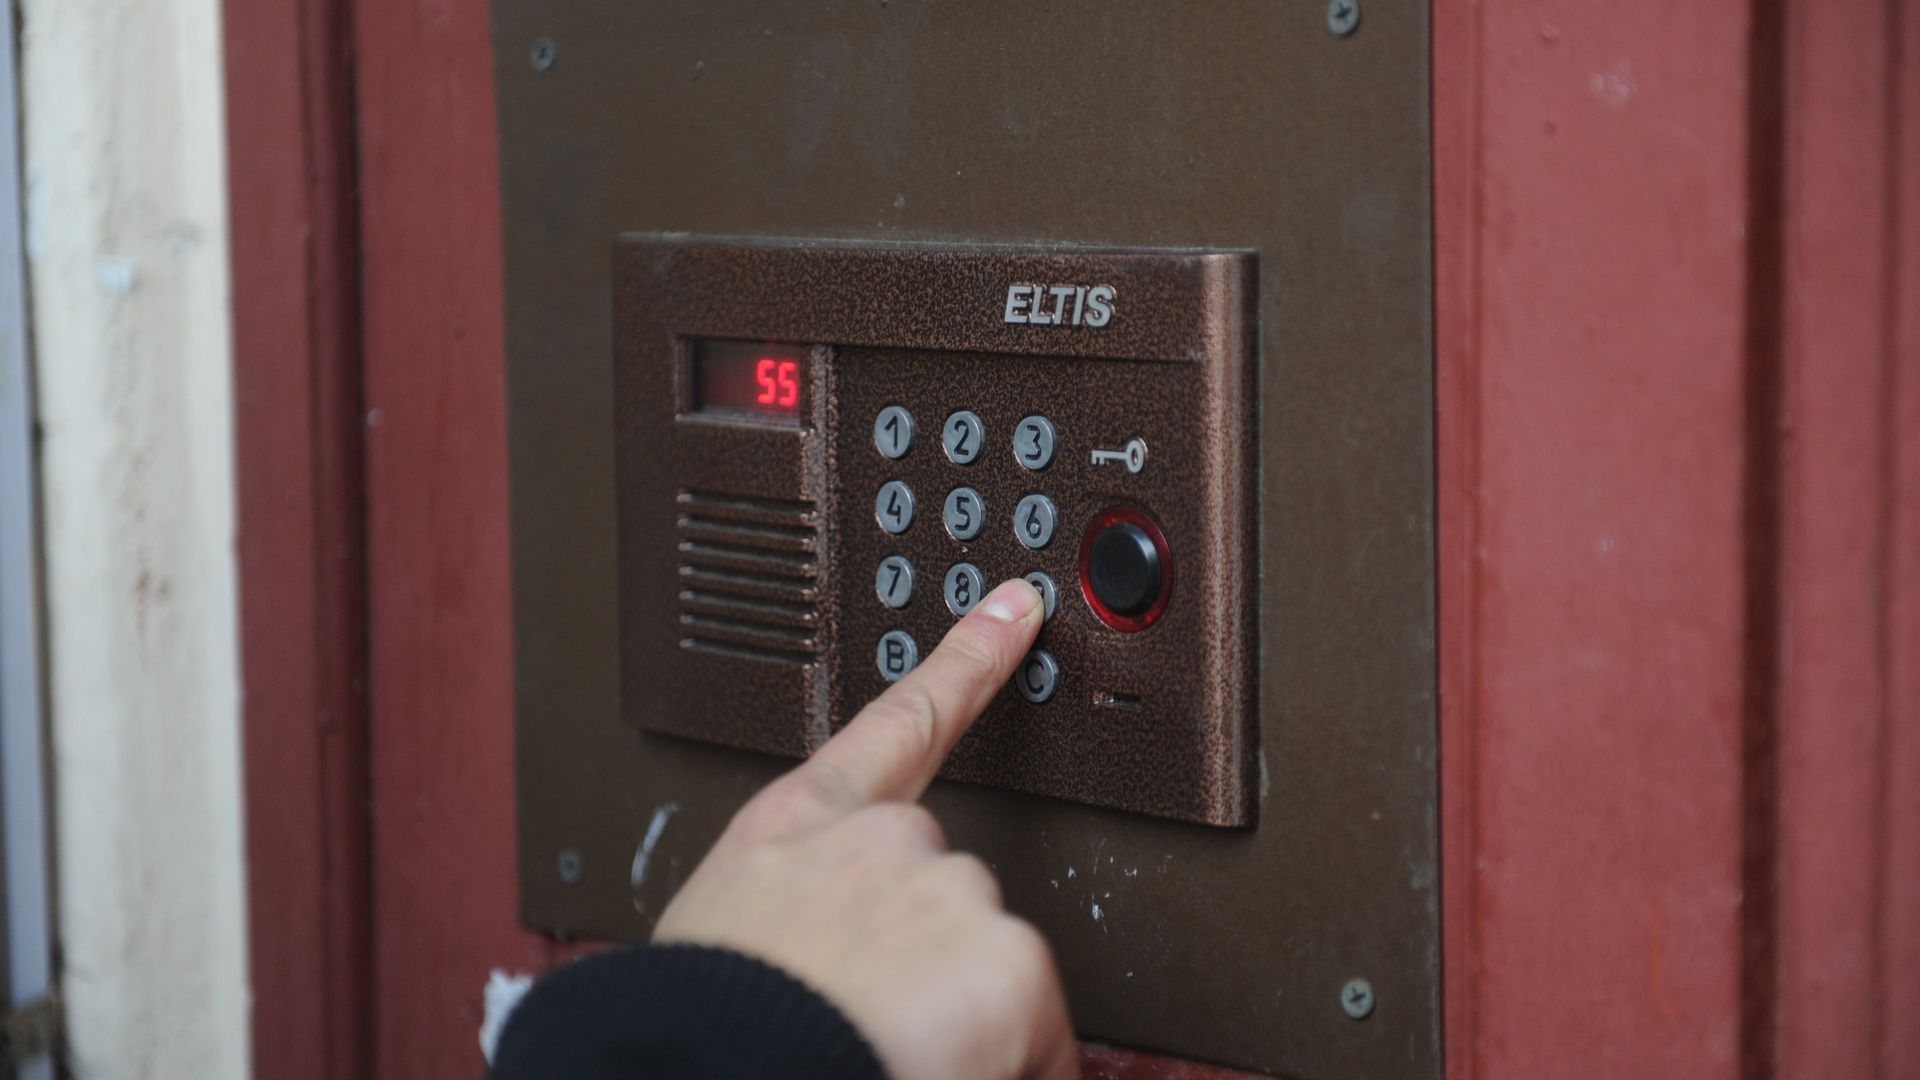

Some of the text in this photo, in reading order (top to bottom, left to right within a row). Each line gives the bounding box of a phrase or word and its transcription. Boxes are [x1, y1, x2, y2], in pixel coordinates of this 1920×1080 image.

[1004, 284, 1114, 327] ELTIS
[757, 358, 798, 407] 55
[884, 415, 898, 450] 1
[954, 419, 970, 456] 2
[1025, 424, 1042, 460] 3
[886, 490, 901, 526] 4
[954, 496, 971, 531] 5
[1025, 503, 1042, 539] 6
[887, 564, 901, 598] 7
[955, 572, 970, 607] 8
[886, 639, 904, 673] B
[1025, 659, 1045, 695] C
